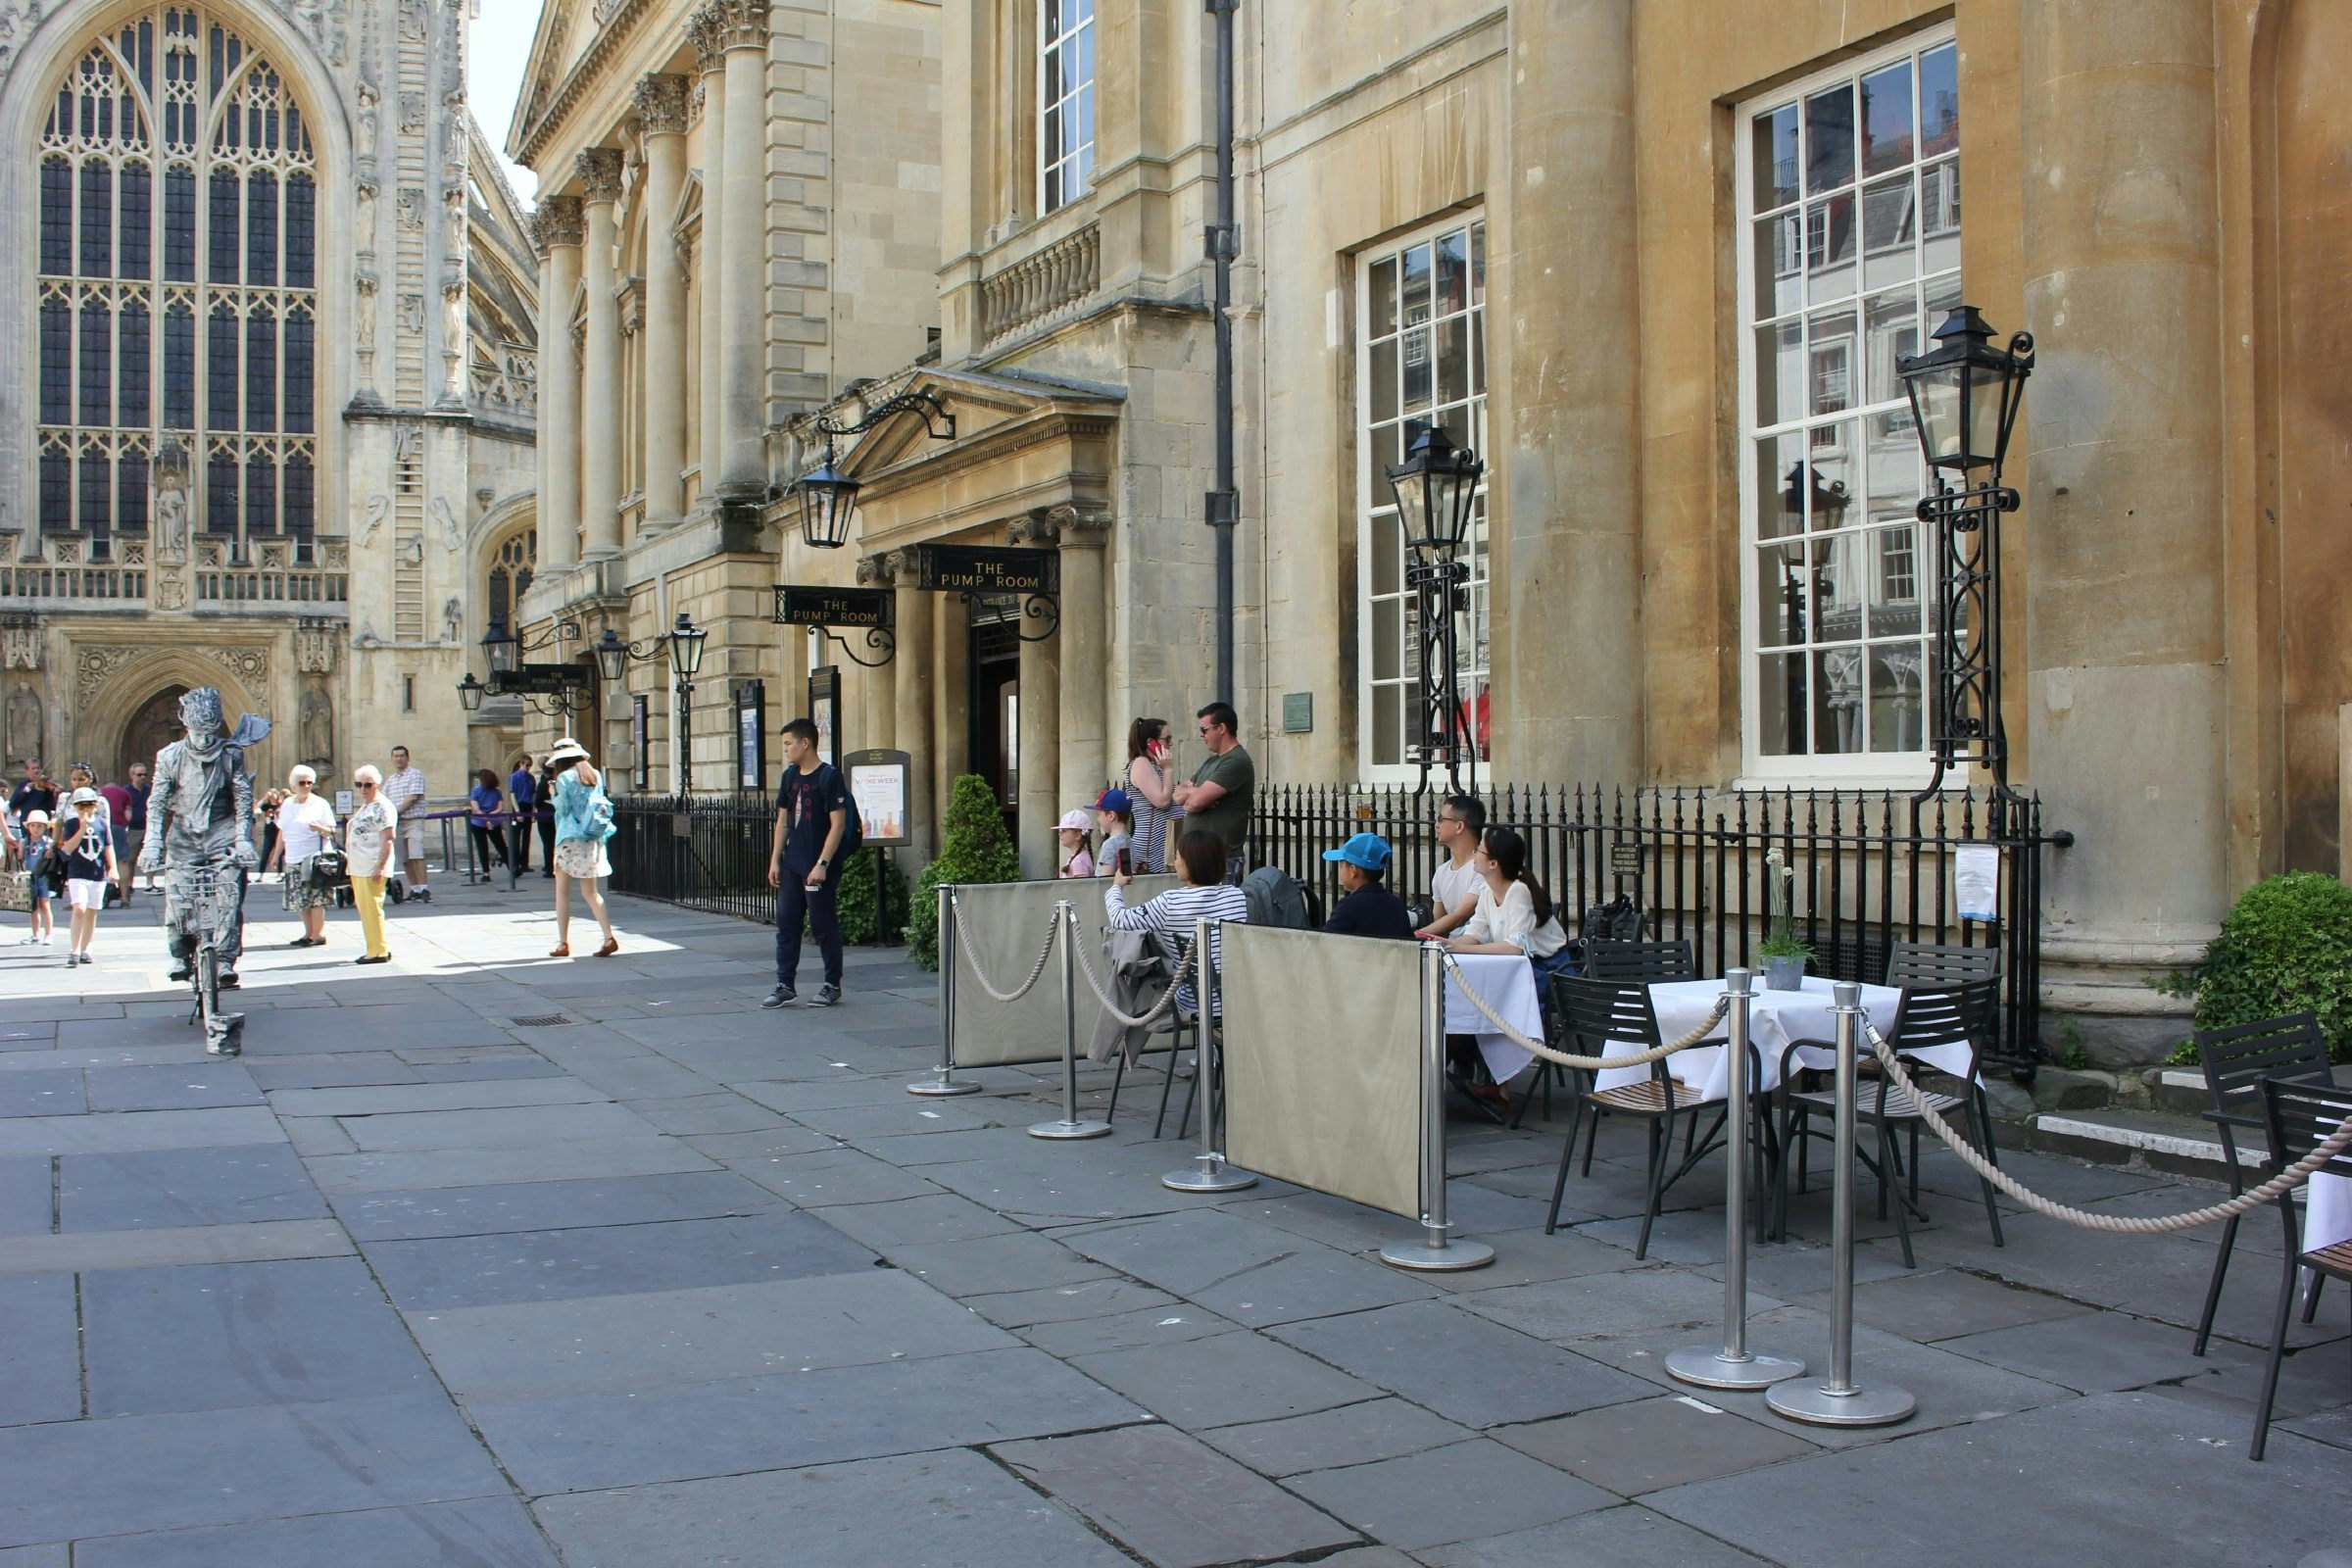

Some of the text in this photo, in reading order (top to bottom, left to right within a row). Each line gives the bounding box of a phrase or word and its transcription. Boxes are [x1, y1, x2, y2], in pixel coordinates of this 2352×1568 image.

[974, 563, 1004, 574] THE
[941, 574, 1039, 588] PUMP ROOM
[822, 600, 849, 612] THE
[793, 611, 878, 622] PUMP ROOM
